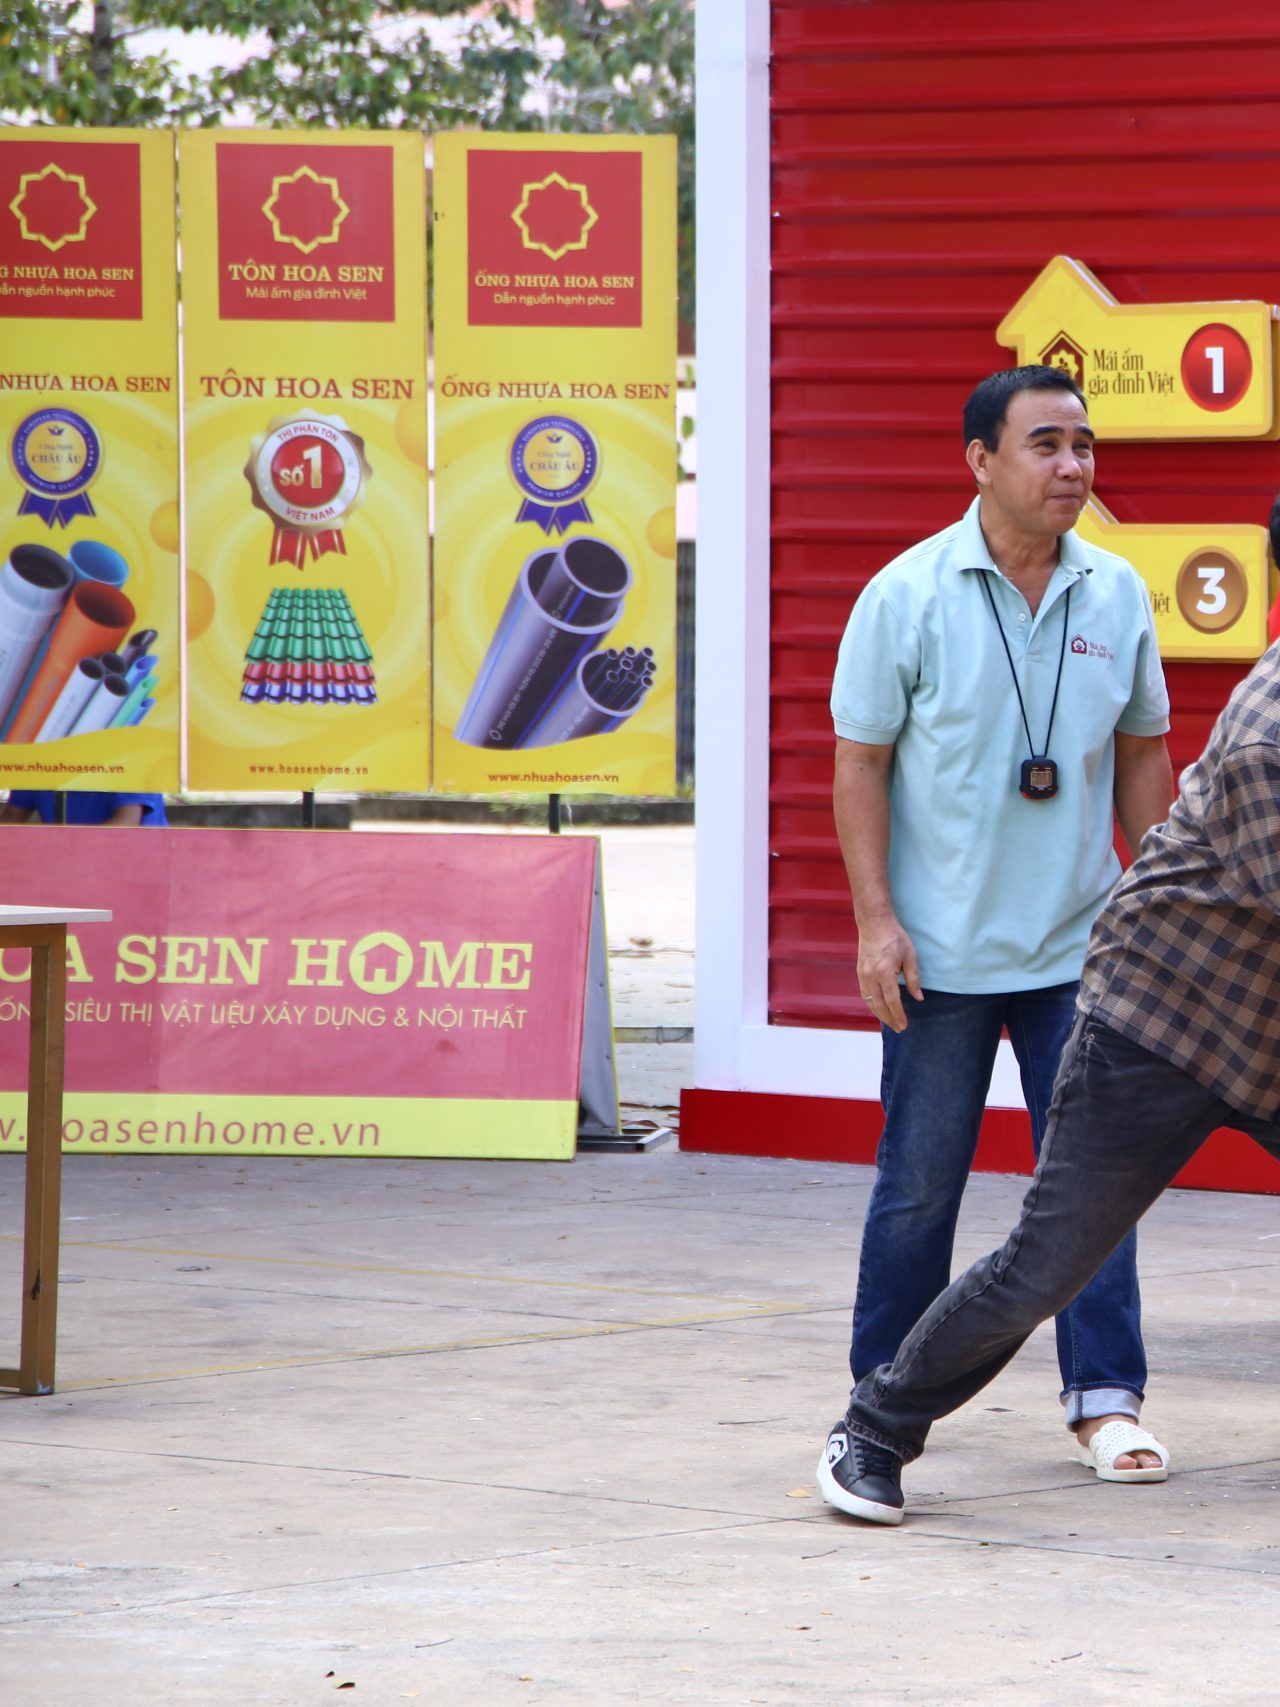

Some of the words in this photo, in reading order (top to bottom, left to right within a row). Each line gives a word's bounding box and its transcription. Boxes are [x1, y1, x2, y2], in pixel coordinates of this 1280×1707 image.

[13, 265, 60, 282] NHỰA
[63, 267, 98, 280] HOA
[102, 268, 135, 281] SEN
[228, 258, 276, 281] TÔN
[282, 265, 332, 282] HOA
[338, 266, 384, 283] SEN
[474, 268, 511, 288] ỐNG
[514, 274, 560, 290] NHỰA
[564, 276, 599, 288] HOA
[602, 277, 635, 288] SEN
[0, 283, 16, 295] ẫn
[56, 286, 85, 299] hạnh
[87, 287, 116, 298] phúc
[246, 287, 268, 298] Mái
[271, 286, 292, 298] ấm
[293, 288, 312, 301] gia
[314, 288, 341, 300] đình
[343, 288, 368, 301] Việt
[494, 292, 517, 304] Dẫn
[519, 292, 555, 306] nguồn
[557, 295, 585, 306] hạnh
[587, 295, 616, 306] phúc
[1094, 349, 1118, 371] Mái
[1122, 348, 1144, 371] ấm
[1205, 347, 1224, 394] 1
[70, 373, 120, 392] HOA
[125, 376, 172, 393] SEN
[200, 368, 266, 398] TÔN
[274, 378, 343, 399] HOA
[352, 379, 415, 400] SEN
[441, 374, 491, 398] ỐNG
[498, 380, 562, 403] NHỰA
[569, 383, 618, 400] HOA
[624, 384, 671, 400] SEN
[1088, 375, 1108, 398] gia
[1112, 373, 1145, 394] đình
[1148, 372, 1175, 397] Việt
[303, 445, 323, 489] 1
[310, 507, 335, 521] NAM
[1196, 567, 1227, 615] 3
[1150, 591, 1170, 616] iệt
[0, 762, 124, 775] ww.nhuahoasen.vn
[249, 764, 369, 775] www.hoasenhome.vn
[488, 771, 619, 783] www.nhuahoasen.vn
[0, 934, 94, 983] OA
[115, 935, 269, 985] SEN
[288, 931, 533, 995] HOME
[65, 998, 111, 1022] SIÊU
[120, 1003, 153, 1027] THỊ
[160, 1000, 205, 1028] VẬT
[211, 1000, 255, 1028] LIỆU
[262, 1001, 308, 1025] XÂY
[315, 1005, 386, 1030] DỰNG
[394, 1008, 409, 1027] &
[418, 1004, 463, 1031] NỘI
[472, 1003, 528, 1029] THẤT
